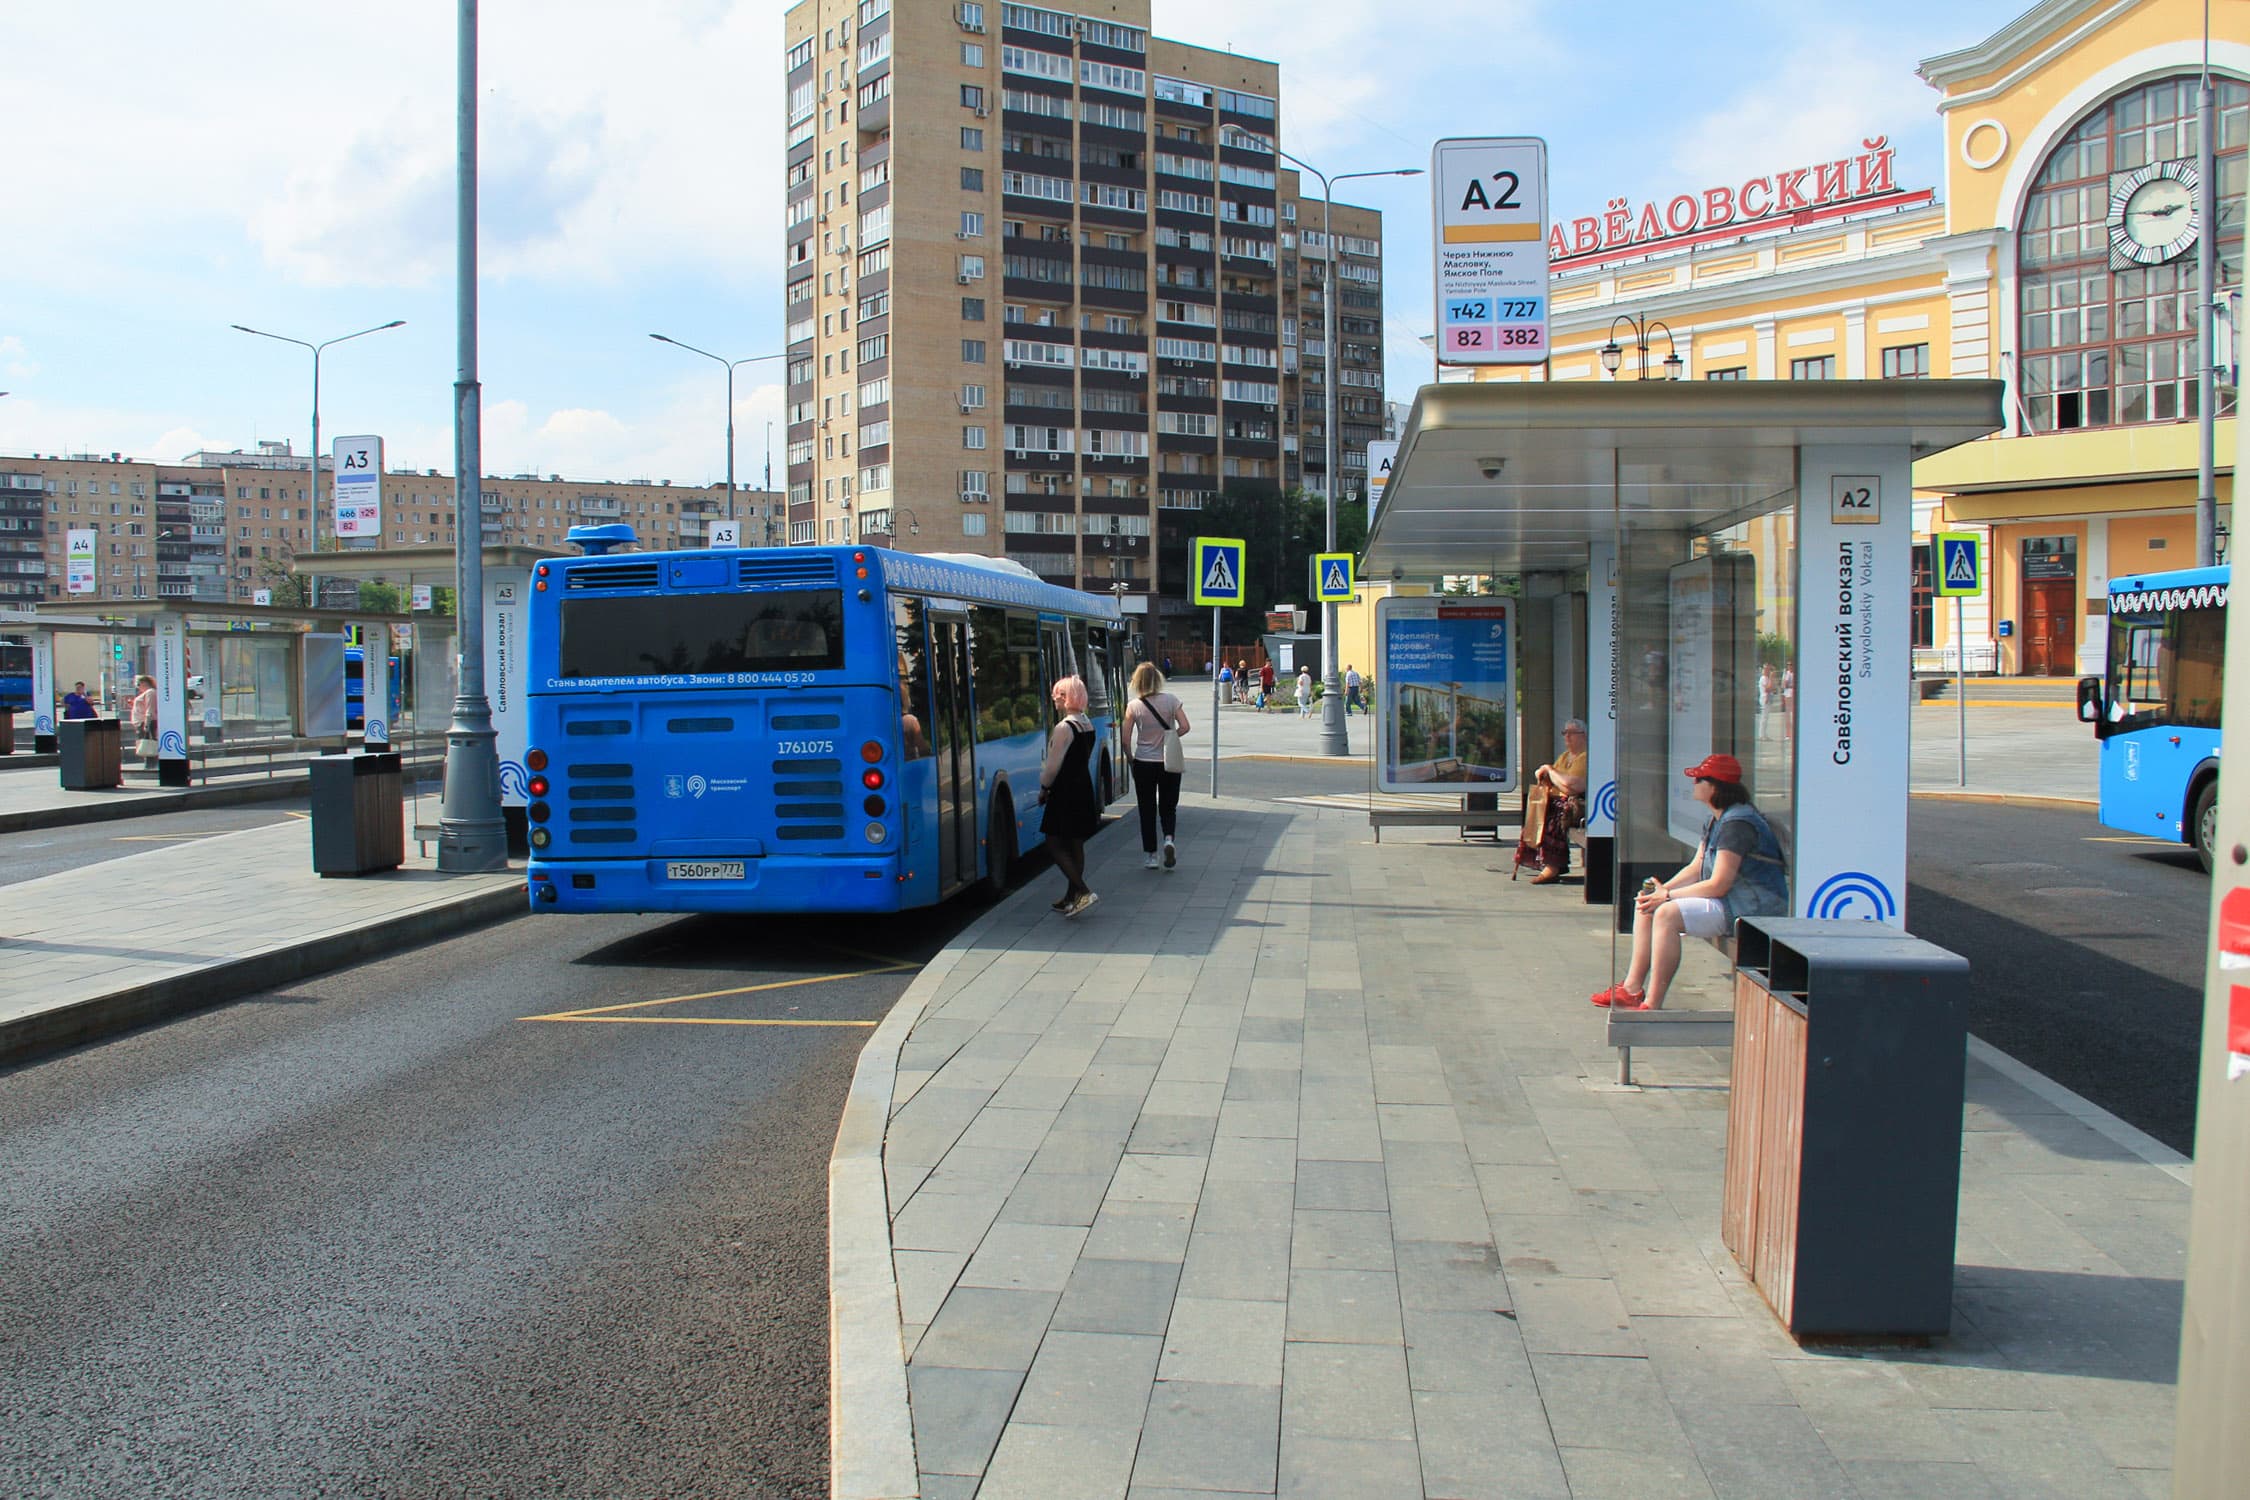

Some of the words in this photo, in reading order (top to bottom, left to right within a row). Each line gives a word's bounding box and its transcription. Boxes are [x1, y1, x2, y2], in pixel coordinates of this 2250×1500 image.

[1461, 171, 1521, 210] А2
[1548, 136, 1896, 258] АВЁЛОВСКИЙ
[1443, 251, 1470, 260] Через
[1473, 250, 1513, 259] Нижнюю
[1444, 260, 1491, 269] Масловку,
[1444, 270, 1477, 278] Ямское
[1480, 268, 1503, 277] Поле
[1452, 303, 1485, 319] т42
[1504, 301, 1537, 317] 727
[1457, 331, 1482, 346] 82
[1503, 329, 1539, 345] 382
[344, 451, 368, 469] А3
[1841, 488, 1871, 508] А2
[716, 530, 732, 541] А3
[74, 540, 88, 551] А4
[1859, 541, 1873, 587] Vokzal
[1839, 541, 1852, 616] вокзал
[499, 588, 512, 598] А3
[498, 612, 506, 647] вокзал
[1859, 592, 1874, 678] Savyolovskiy
[497, 648, 507, 712] Савёловский
[547, 678, 576, 687] Стань
[578, 677, 635, 687] водителем
[637, 674, 687, 686] автобуса.
[689, 674, 726, 684] Звони:
[727, 673, 734, 683] 8
[737, 673, 759, 683] 800
[761, 673, 781, 683] 444
[784, 673, 798, 682] 05
[801, 672, 815, 682] 20
[1833, 622, 1852, 765] Савёловский
[778, 741, 833, 754] 1761075
[722, 863, 741, 873] 777
